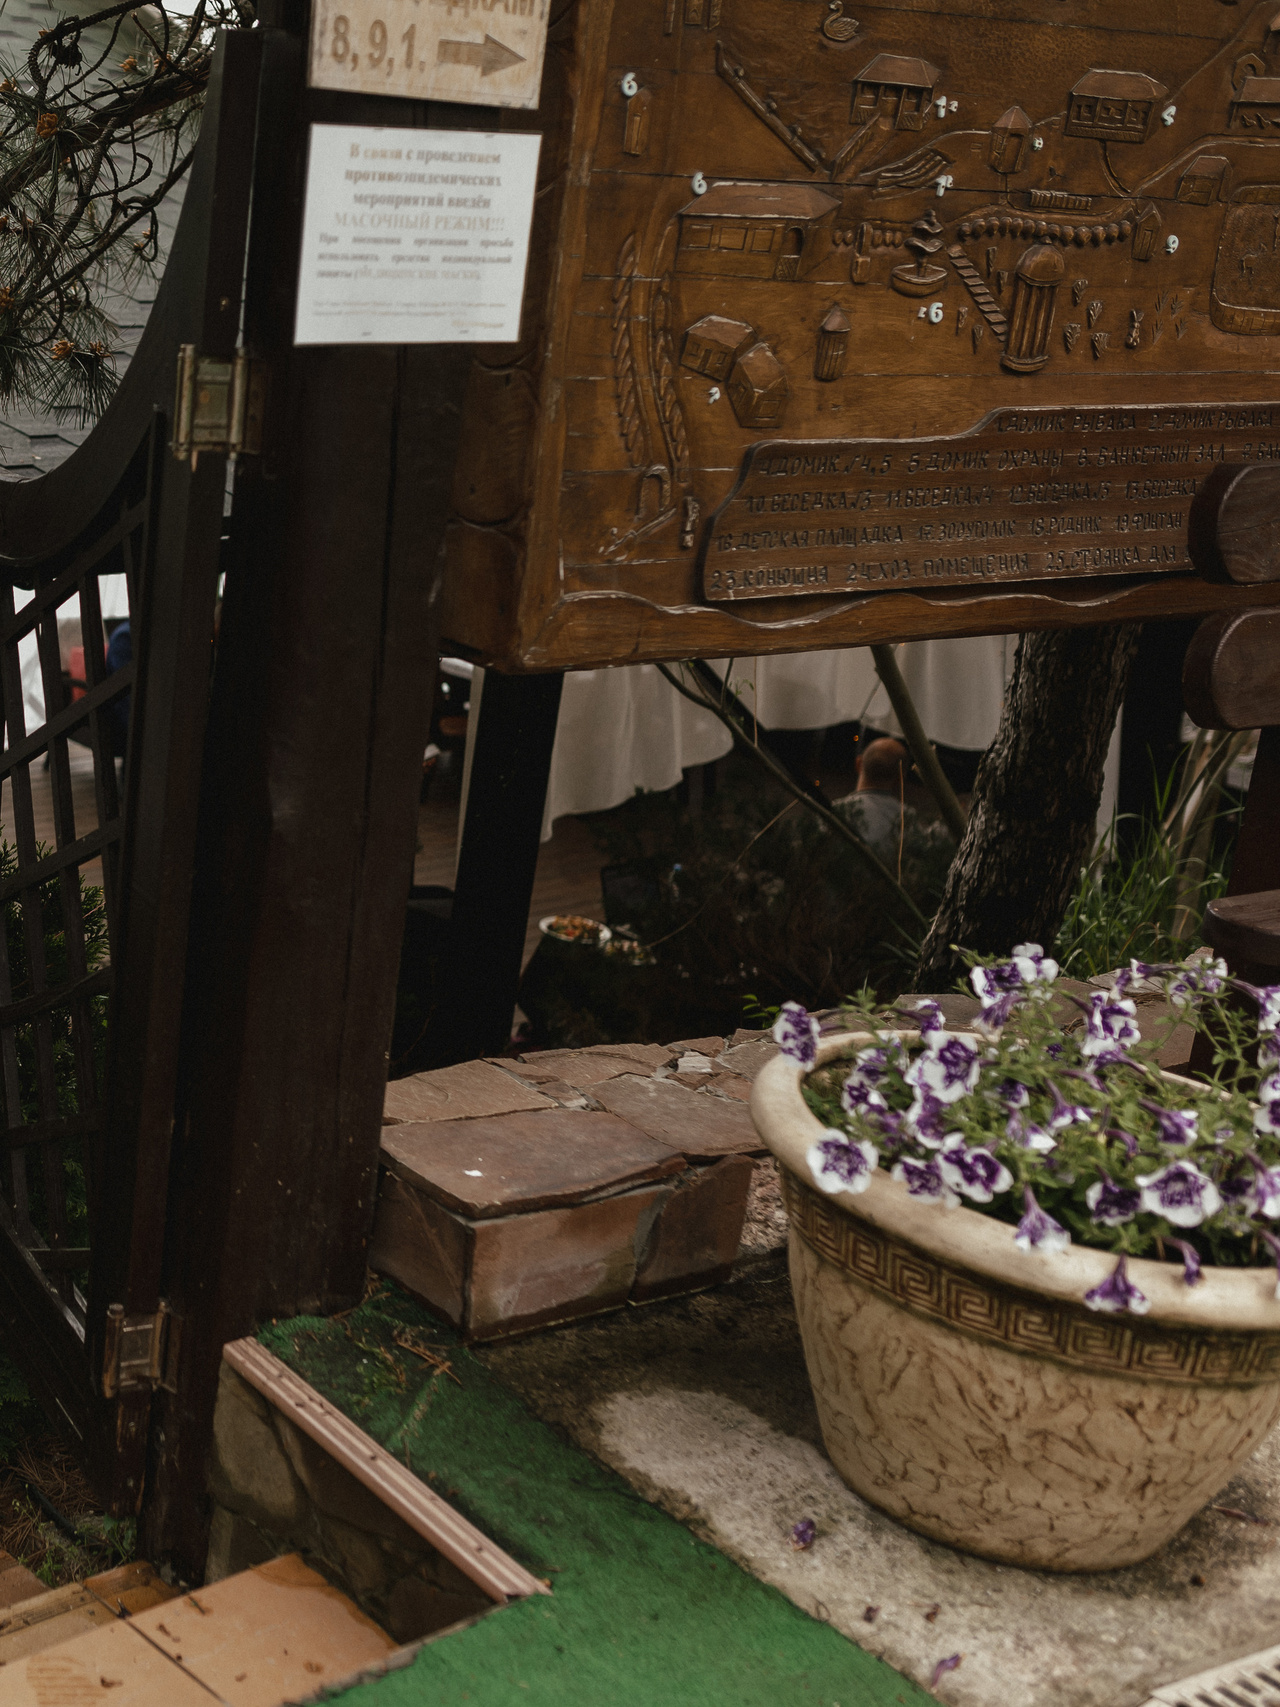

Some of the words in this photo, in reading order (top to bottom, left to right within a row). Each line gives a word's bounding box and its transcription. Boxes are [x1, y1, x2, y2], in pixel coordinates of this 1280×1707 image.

[349, 143, 360, 159] В
[363, 146, 403, 161] связи
[406, 149, 413, 161] с
[416, 148, 501, 165] проведением
[344, 168, 503, 187] противоэпидемических
[352, 192, 444, 209] мероприятий
[447, 194, 491, 209] введён
[334, 211, 431, 229] МАСОЧНЫЙ
[1072, 412, 1137, 433] РЫБАКА
[1217, 410, 1272, 431] РЫБАКА
[907, 450, 989, 474] 5.ДОМИК
[997, 448, 1064, 471] ОХРАНЫ
[1194, 442, 1226, 464] ЗАЛ
[815, 524, 904, 548] ПЛОЩАДКА
[923, 552, 1029, 578] ПОМЕЩЕНИЯ
[1147, 544, 1177, 565] ДЛЯ
